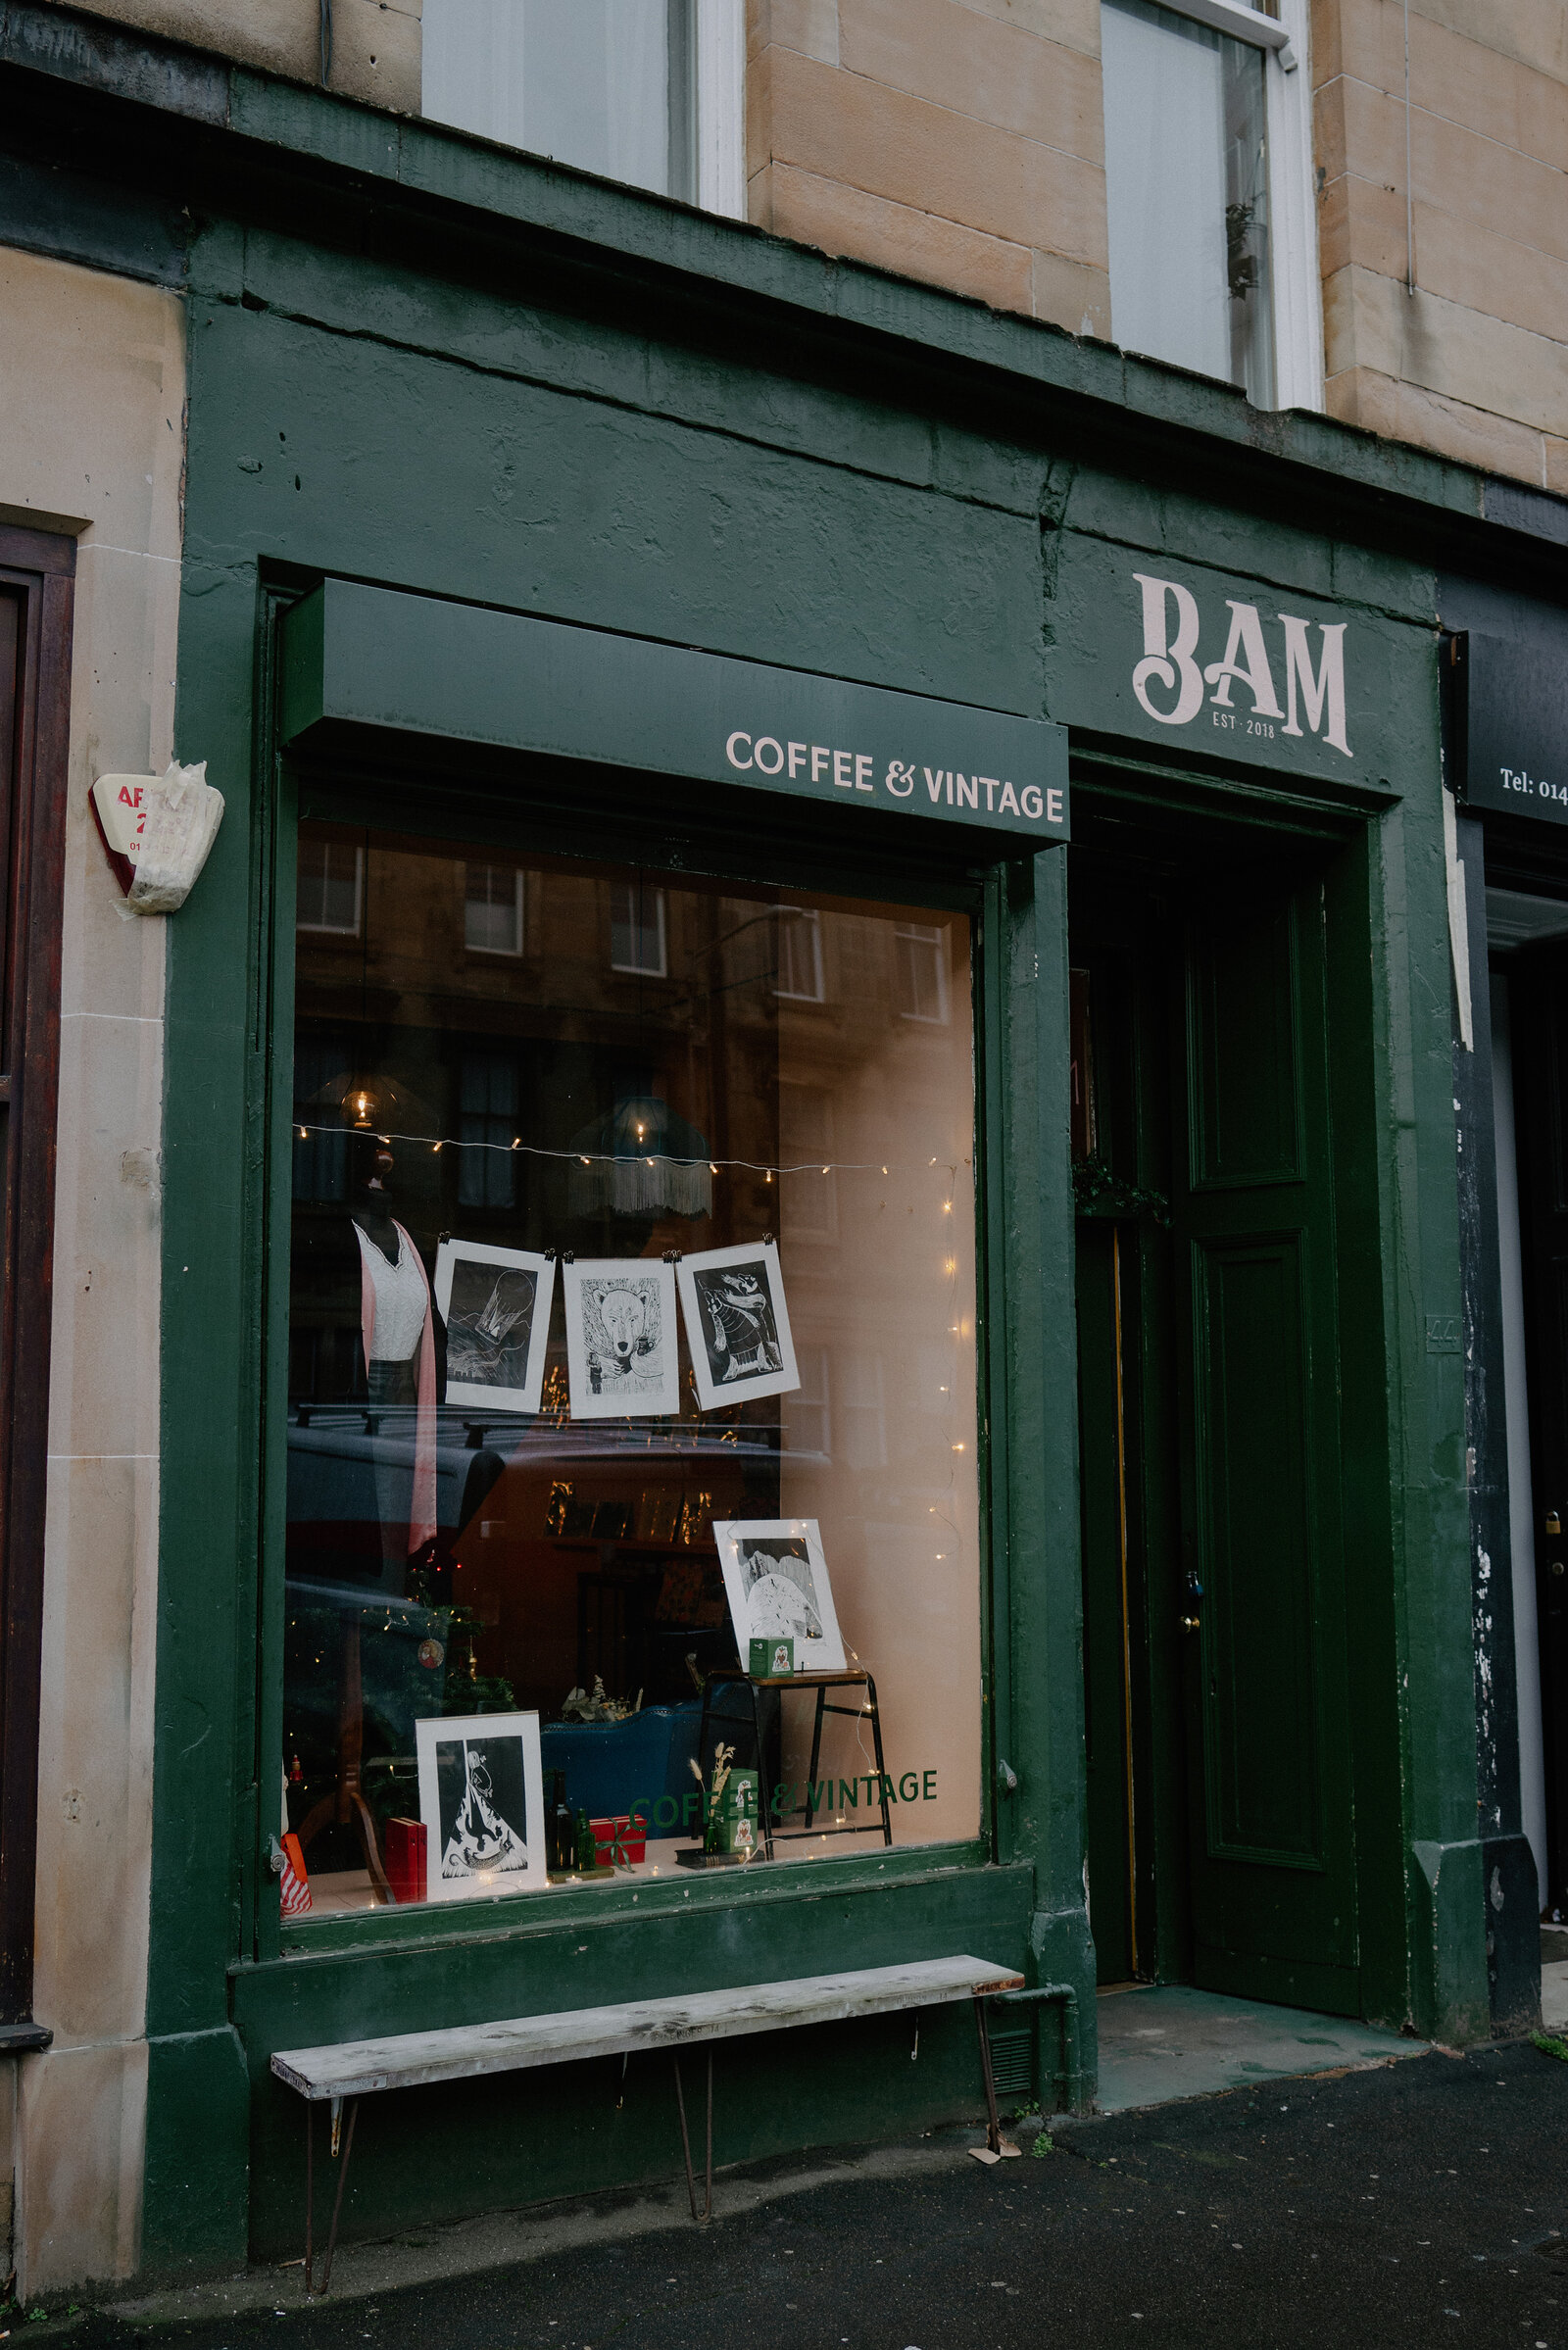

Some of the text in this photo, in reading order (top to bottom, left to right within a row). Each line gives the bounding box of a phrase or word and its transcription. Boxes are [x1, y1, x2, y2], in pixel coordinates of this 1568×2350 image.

[1132, 572, 1354, 759] BAM
[1213, 711, 1275, 739] EST 2018
[725, 731, 1063, 823] COFFEE & VINTAGE
[1499, 767, 1568, 806] Tel: 014
[628, 1770, 937, 1831] COFFEE & VINTAGE
